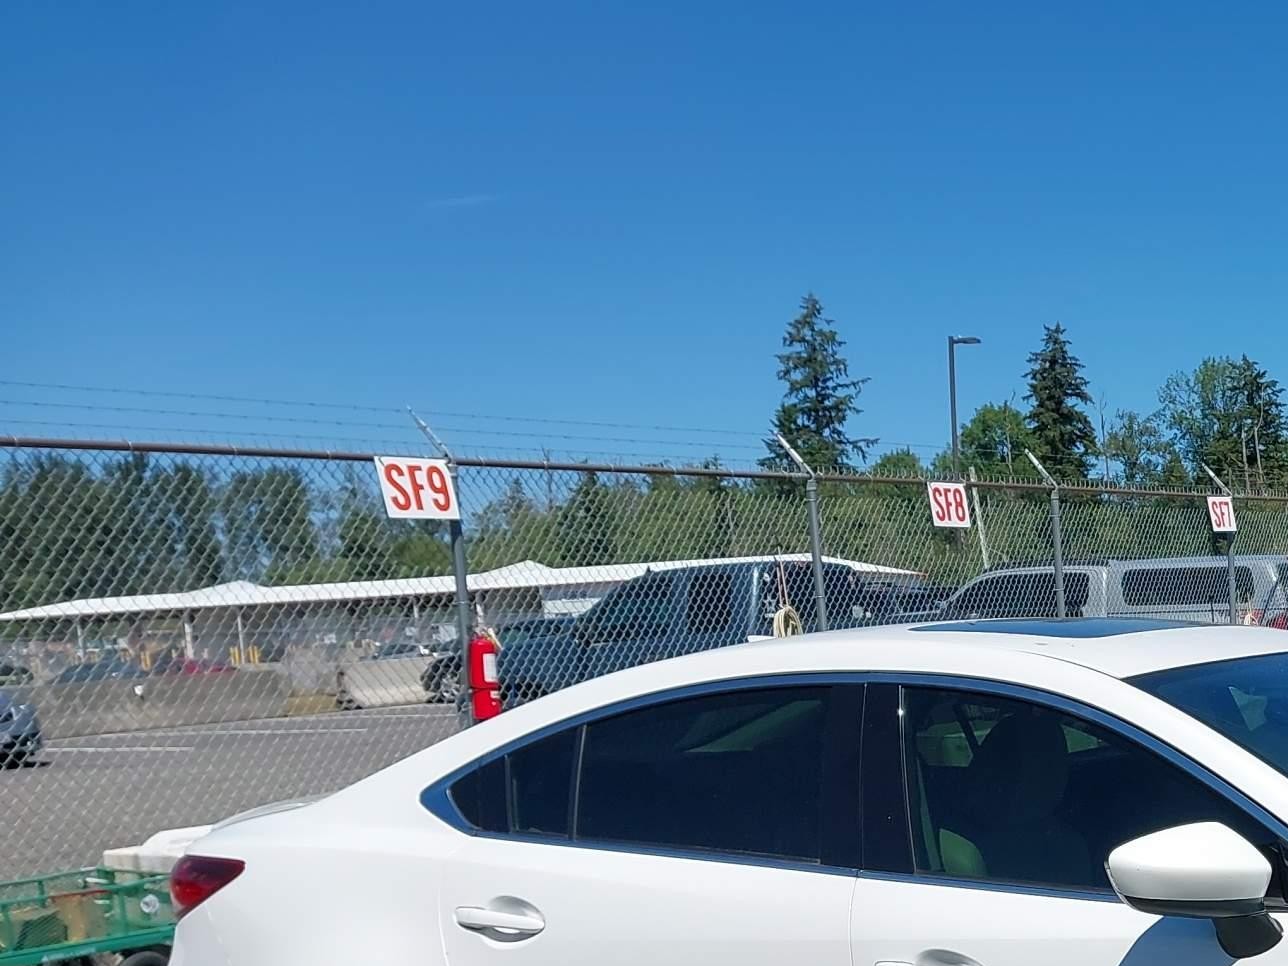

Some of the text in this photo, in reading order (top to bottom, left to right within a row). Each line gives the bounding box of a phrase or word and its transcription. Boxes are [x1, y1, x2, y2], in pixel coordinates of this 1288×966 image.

[384, 463, 450, 511] SF9
[932, 487, 966, 522] SF8
[1211, 501, 1232, 528] SF7
